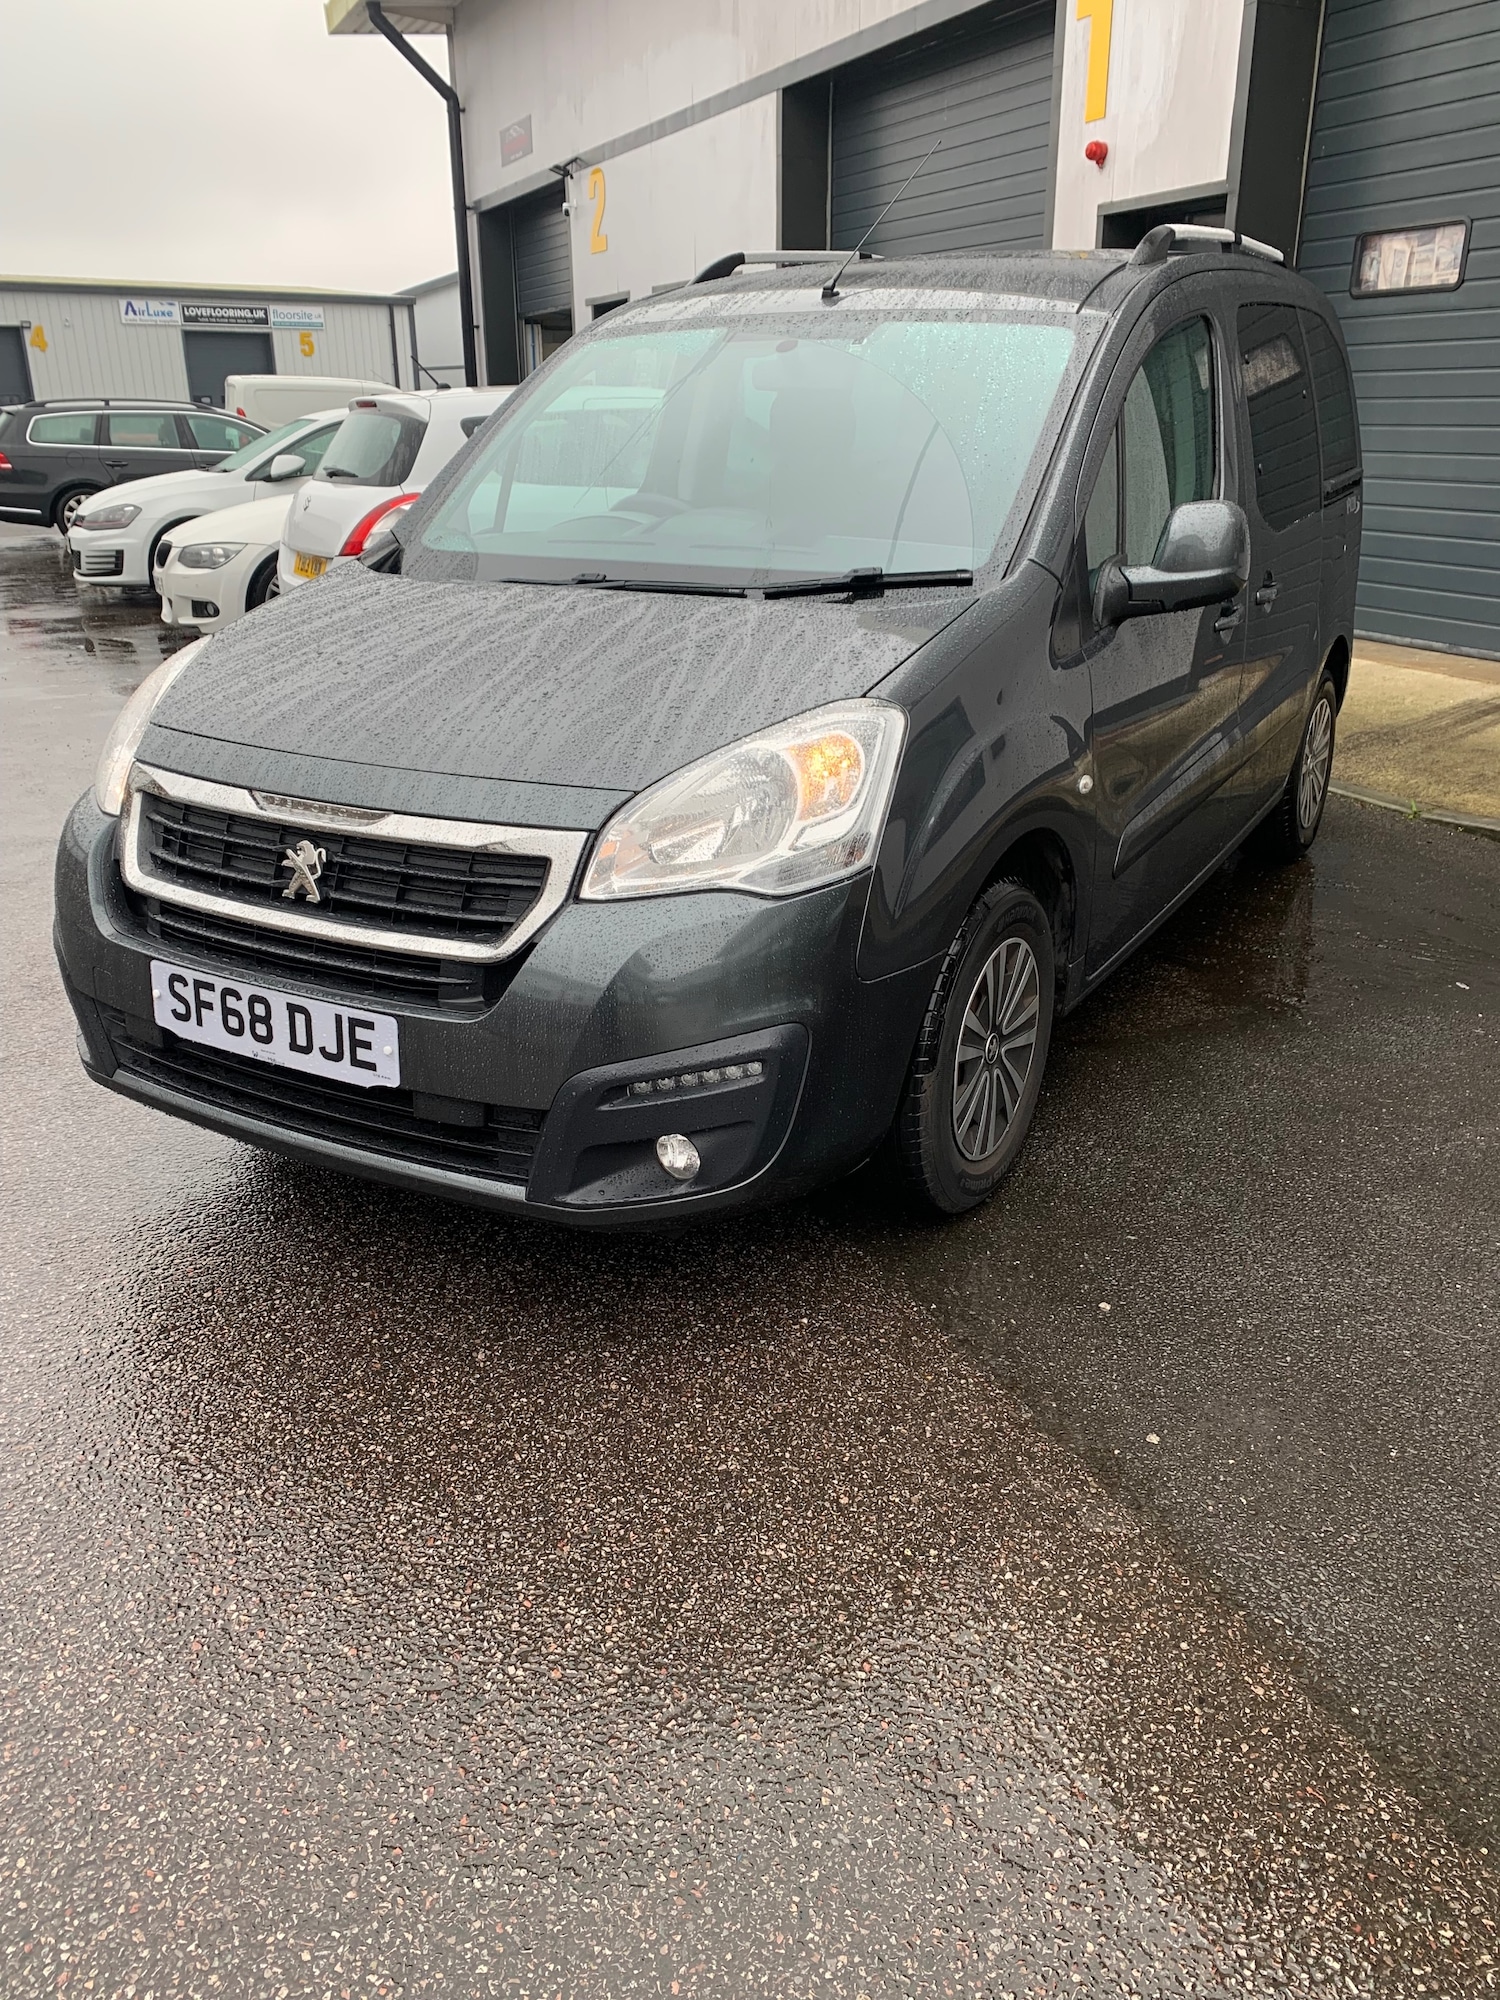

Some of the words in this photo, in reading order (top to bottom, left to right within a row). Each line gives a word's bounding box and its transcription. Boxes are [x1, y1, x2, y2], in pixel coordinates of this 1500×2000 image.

[1076, 0, 1114, 124] 1
[588, 167, 608, 255] 2
[30, 324, 48, 352] 4
[183, 306, 266, 319] LOVEFLOORING.UK
[299, 331, 315, 357] 5
[168, 973, 274, 1045] SF68
[286, 1001, 377, 1072] DJE
